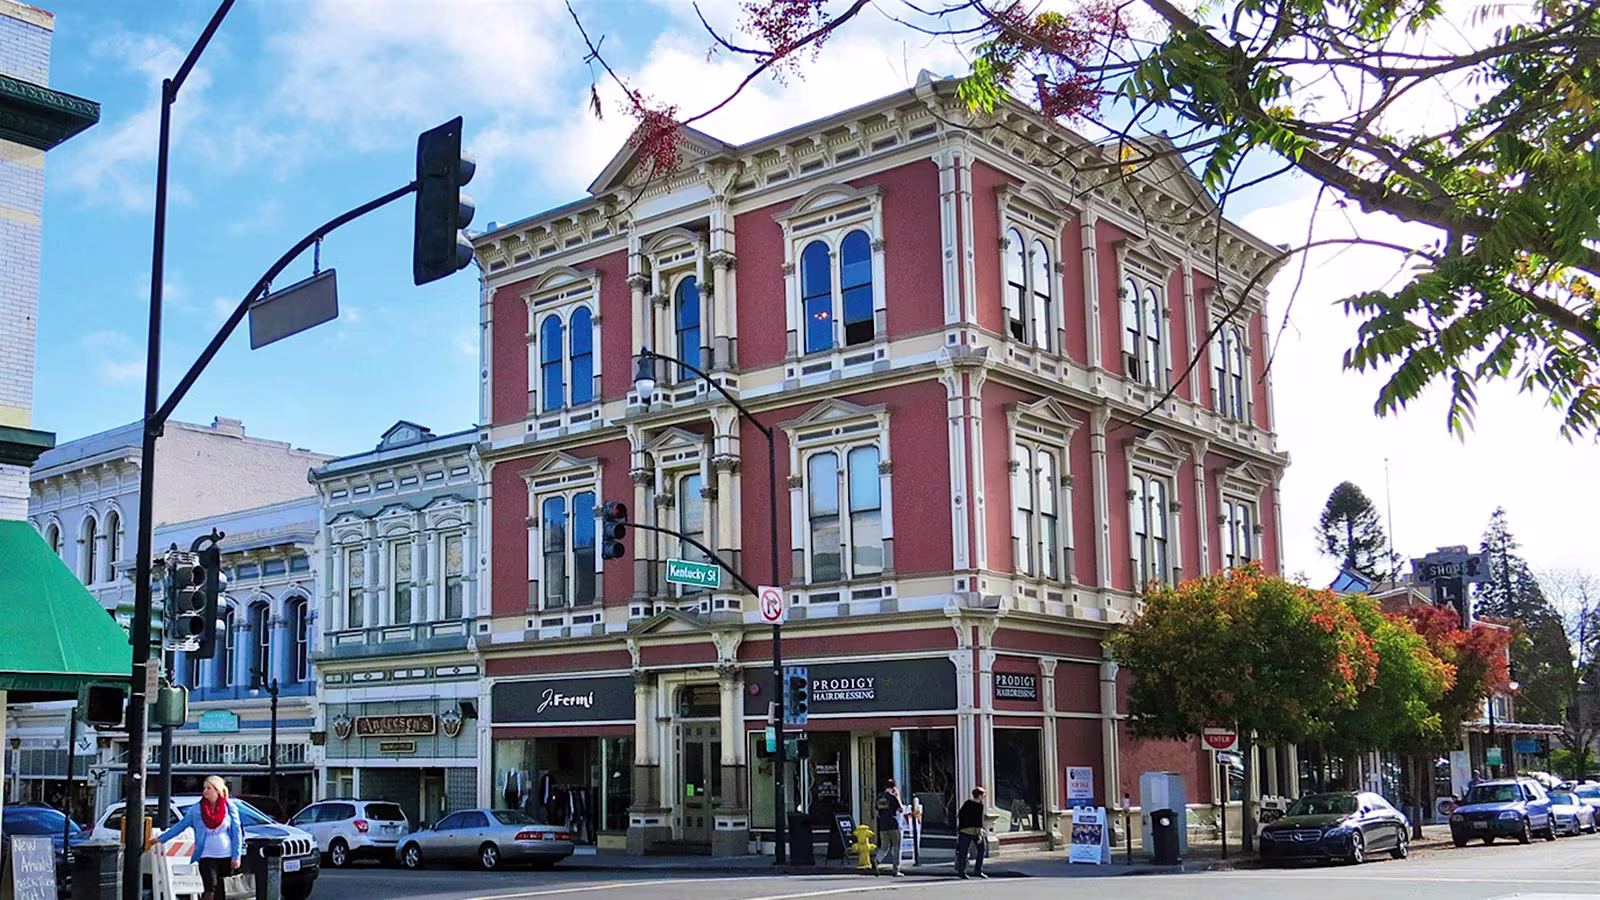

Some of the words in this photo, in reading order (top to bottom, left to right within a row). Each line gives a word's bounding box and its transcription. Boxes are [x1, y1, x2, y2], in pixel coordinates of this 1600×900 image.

[670, 564, 706, 583] Kentucky
[706, 569, 717, 582] St
[1429, 563, 1469, 577] SHOPS
[812, 677, 875, 690] PRODIGY
[995, 674, 1036, 687] PRODIGY
[536, 688, 594, 714] J.Fermi
[812, 690, 875, 702] HAIRDRESSING
[360, 716, 430, 733] Andresen's
[1209, 735, 1231, 744] ENTER
[13, 839, 37, 852] New
